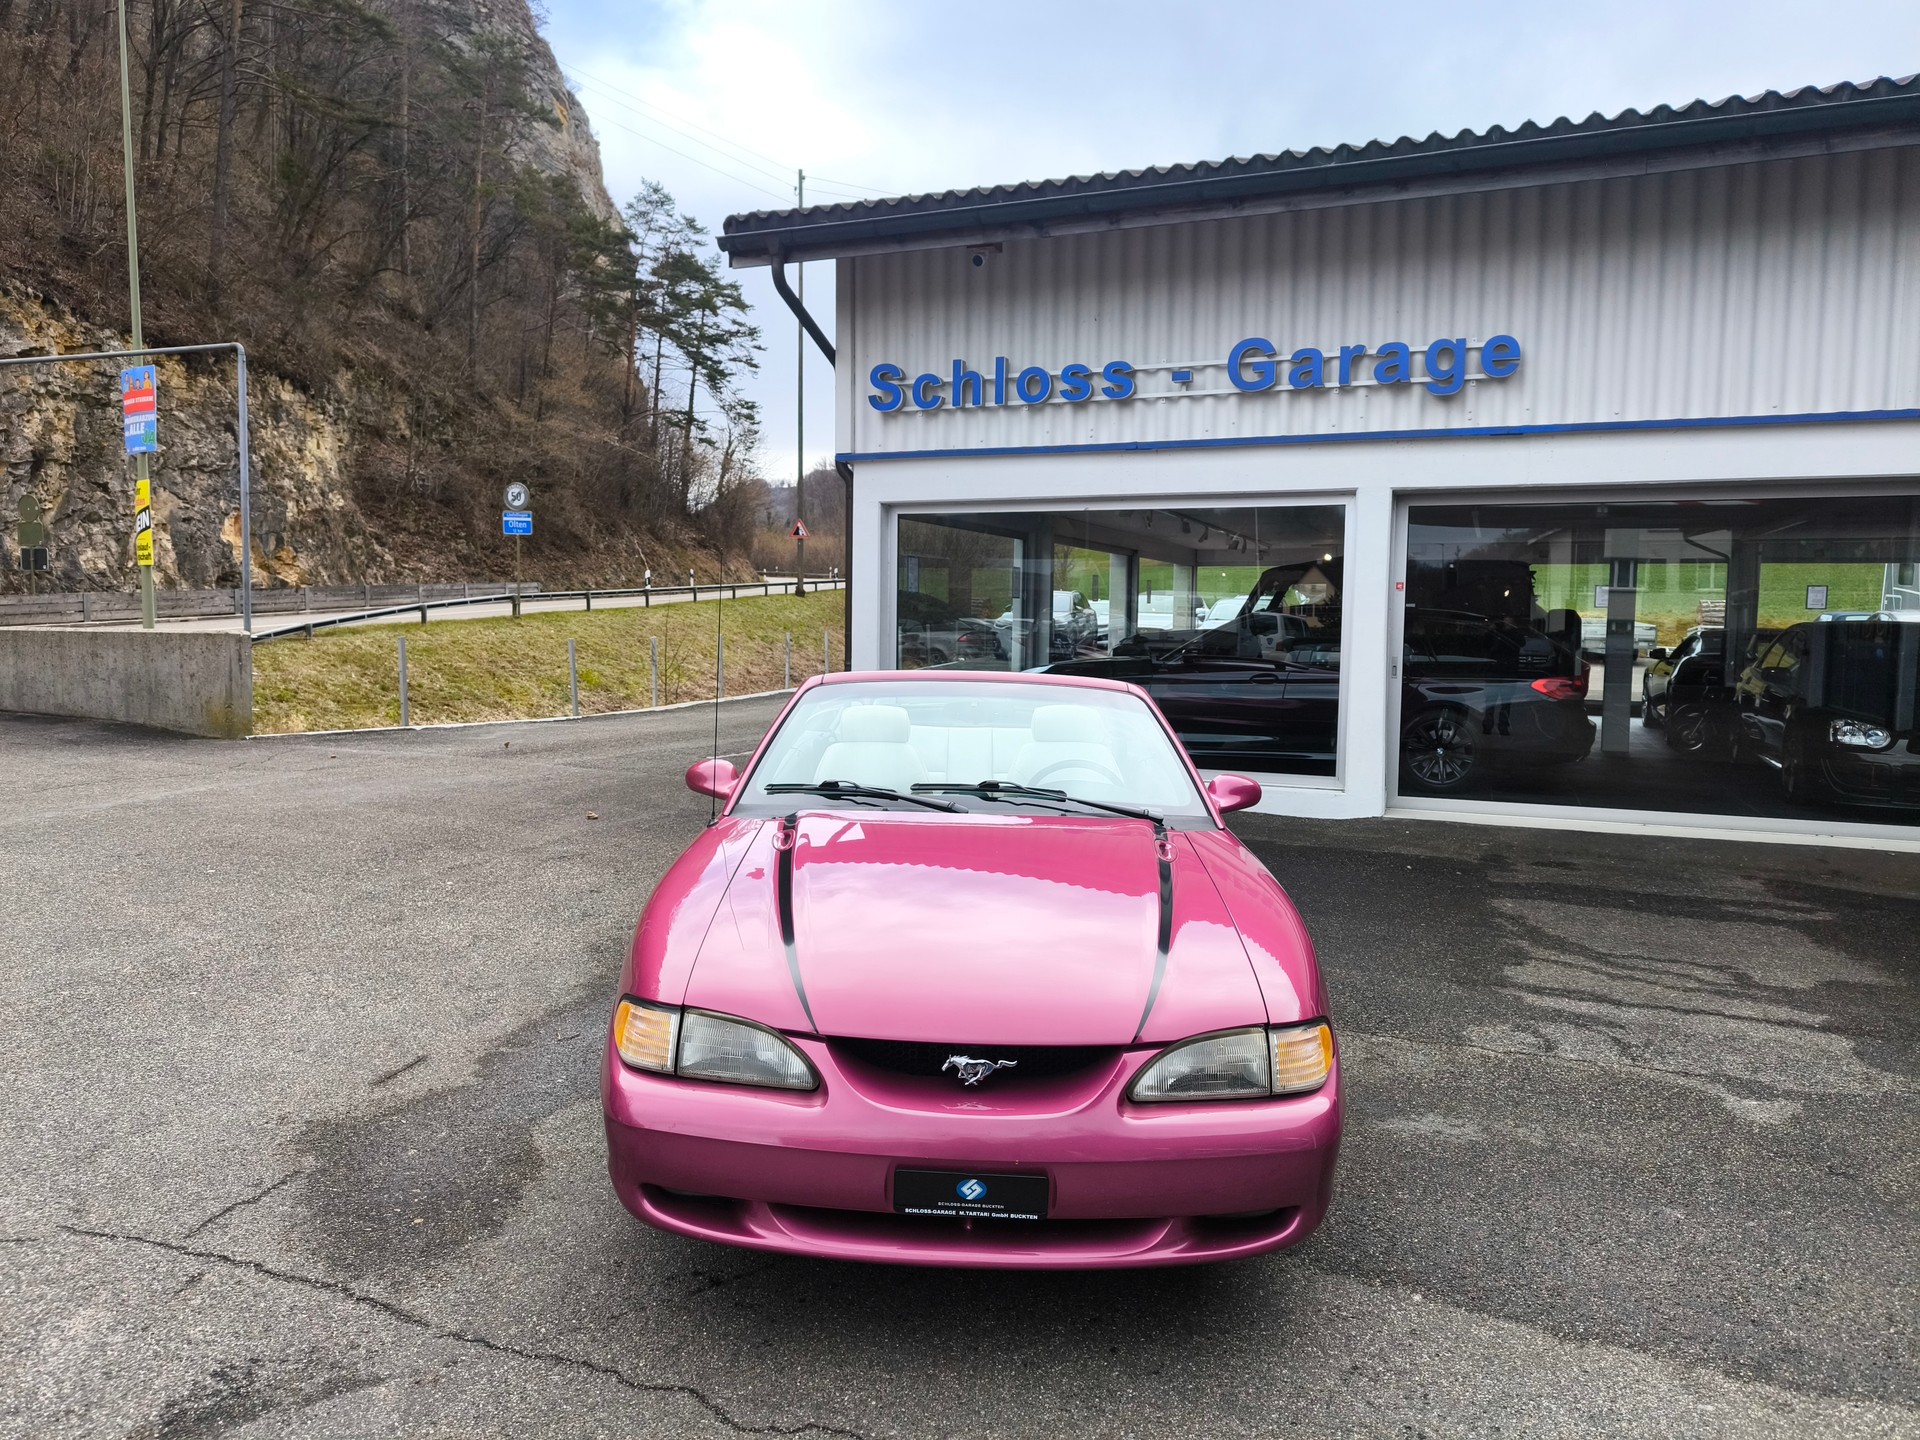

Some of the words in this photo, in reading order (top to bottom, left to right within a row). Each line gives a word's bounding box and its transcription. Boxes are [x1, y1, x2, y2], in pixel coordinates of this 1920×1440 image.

[869, 356, 1136, 412] Schloss
[1172, 370, 1192, 383] -
[1227, 334, 1522, 396] Garage
[142, 429, 155, 444] JA
[511, 491, 521, 501] 50
[508, 520, 527, 528] Olten
[904, 1207, 956, 1216] SCHLOSS-GARAGE
